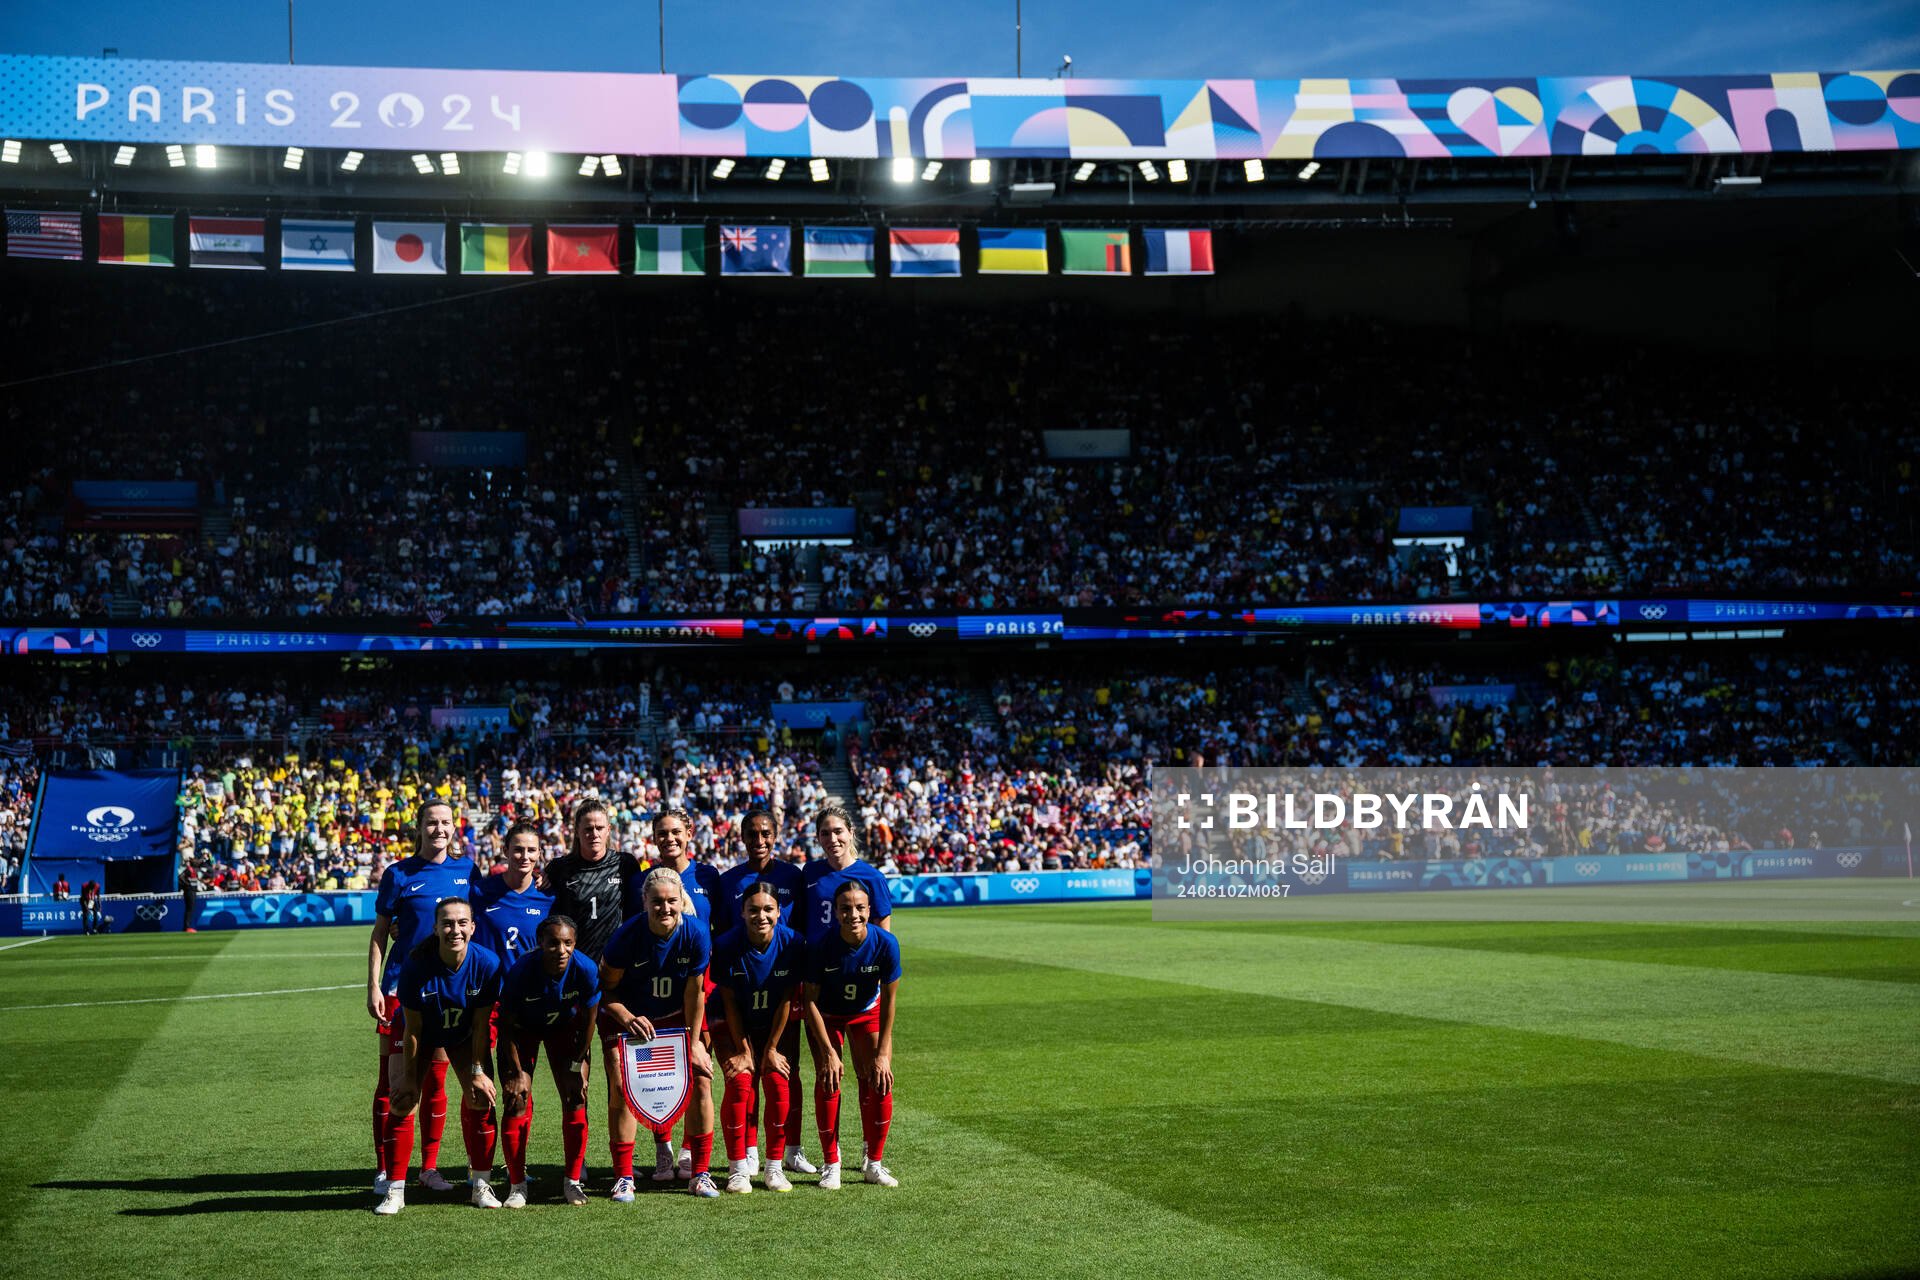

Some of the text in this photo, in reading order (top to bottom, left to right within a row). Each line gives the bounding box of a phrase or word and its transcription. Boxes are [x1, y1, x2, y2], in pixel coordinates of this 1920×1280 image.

[329, 90, 522, 132] 2024
[985, 621, 1037, 635] PARIS
[29, 911, 65, 922] PARIS
[590, 896, 598, 920] 1
[820, 900, 832, 924] 3
[505, 926, 519, 950] 2
[860, 965, 880, 974] USA
[651, 976, 672, 998] 10
[843, 983, 857, 1000] 9
[752, 990, 769, 1010] 11
[442, 1007, 463, 1029] 17
[546, 1011, 560, 1025] 7
